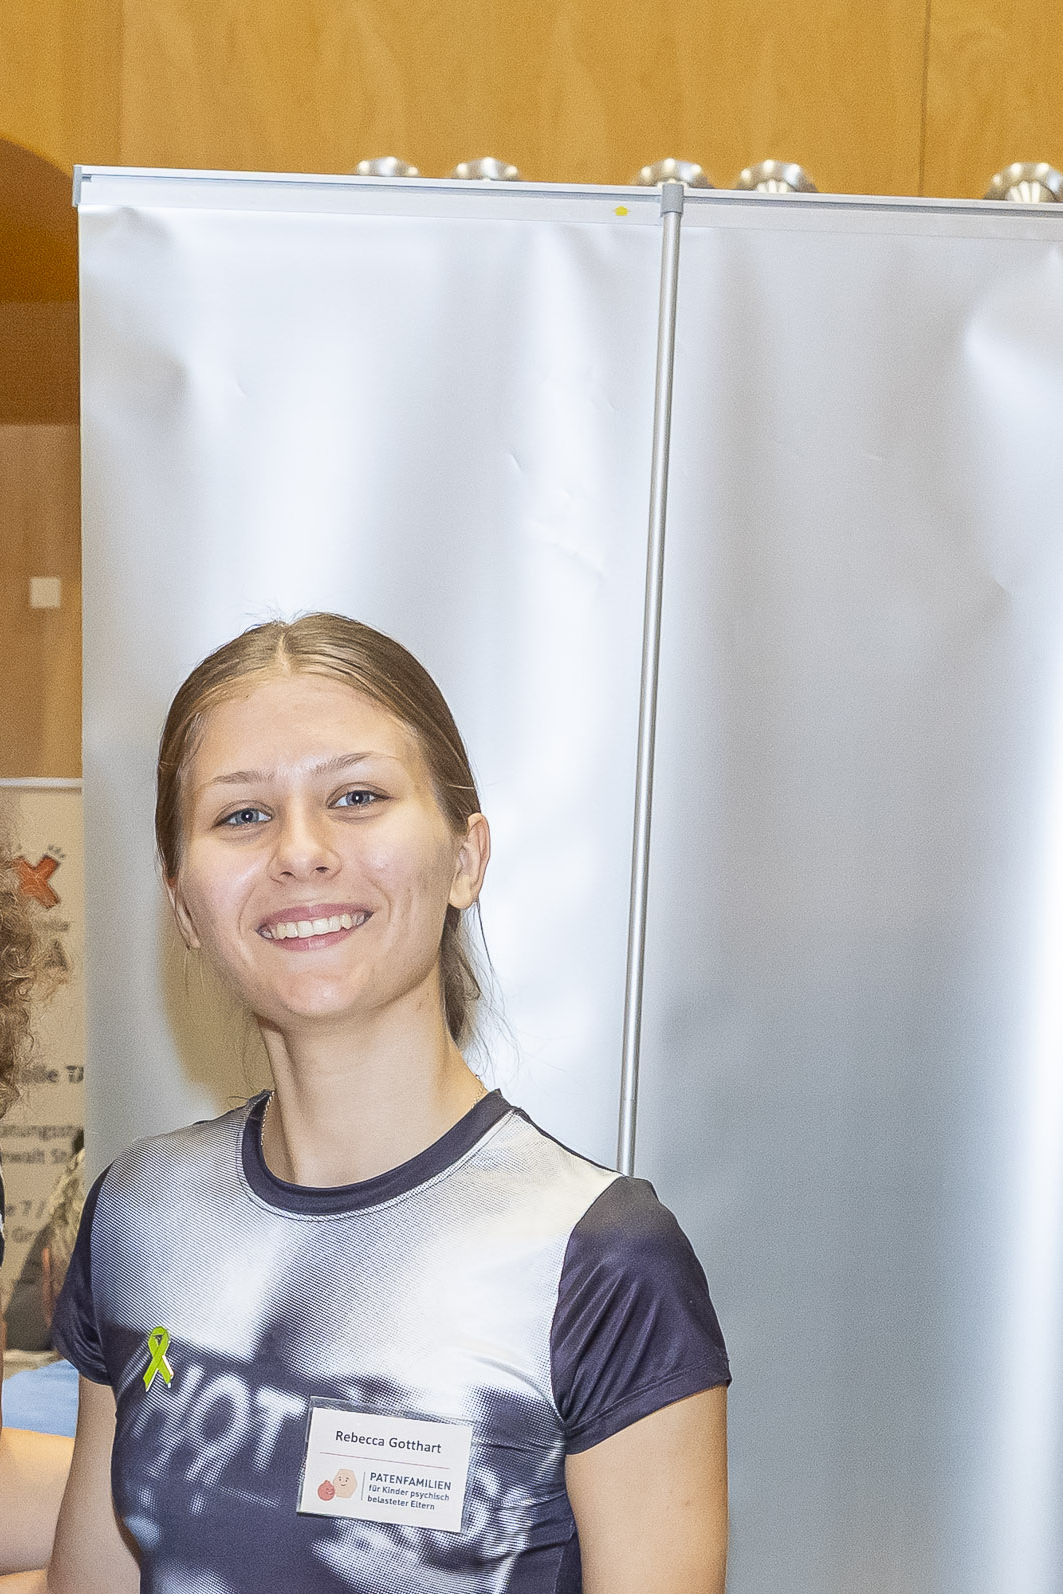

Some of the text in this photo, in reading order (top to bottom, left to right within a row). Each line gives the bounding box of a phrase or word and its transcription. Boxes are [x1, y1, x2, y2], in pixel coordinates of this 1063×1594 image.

[335, 1430, 442, 1453] Rebecca Gotthart
[369, 1472, 452, 1491] PATENFAMILIEN
[368, 1484, 450, 1502] für Kinder psychisch
[367, 1495, 435, 1510] belasteter Eltern
